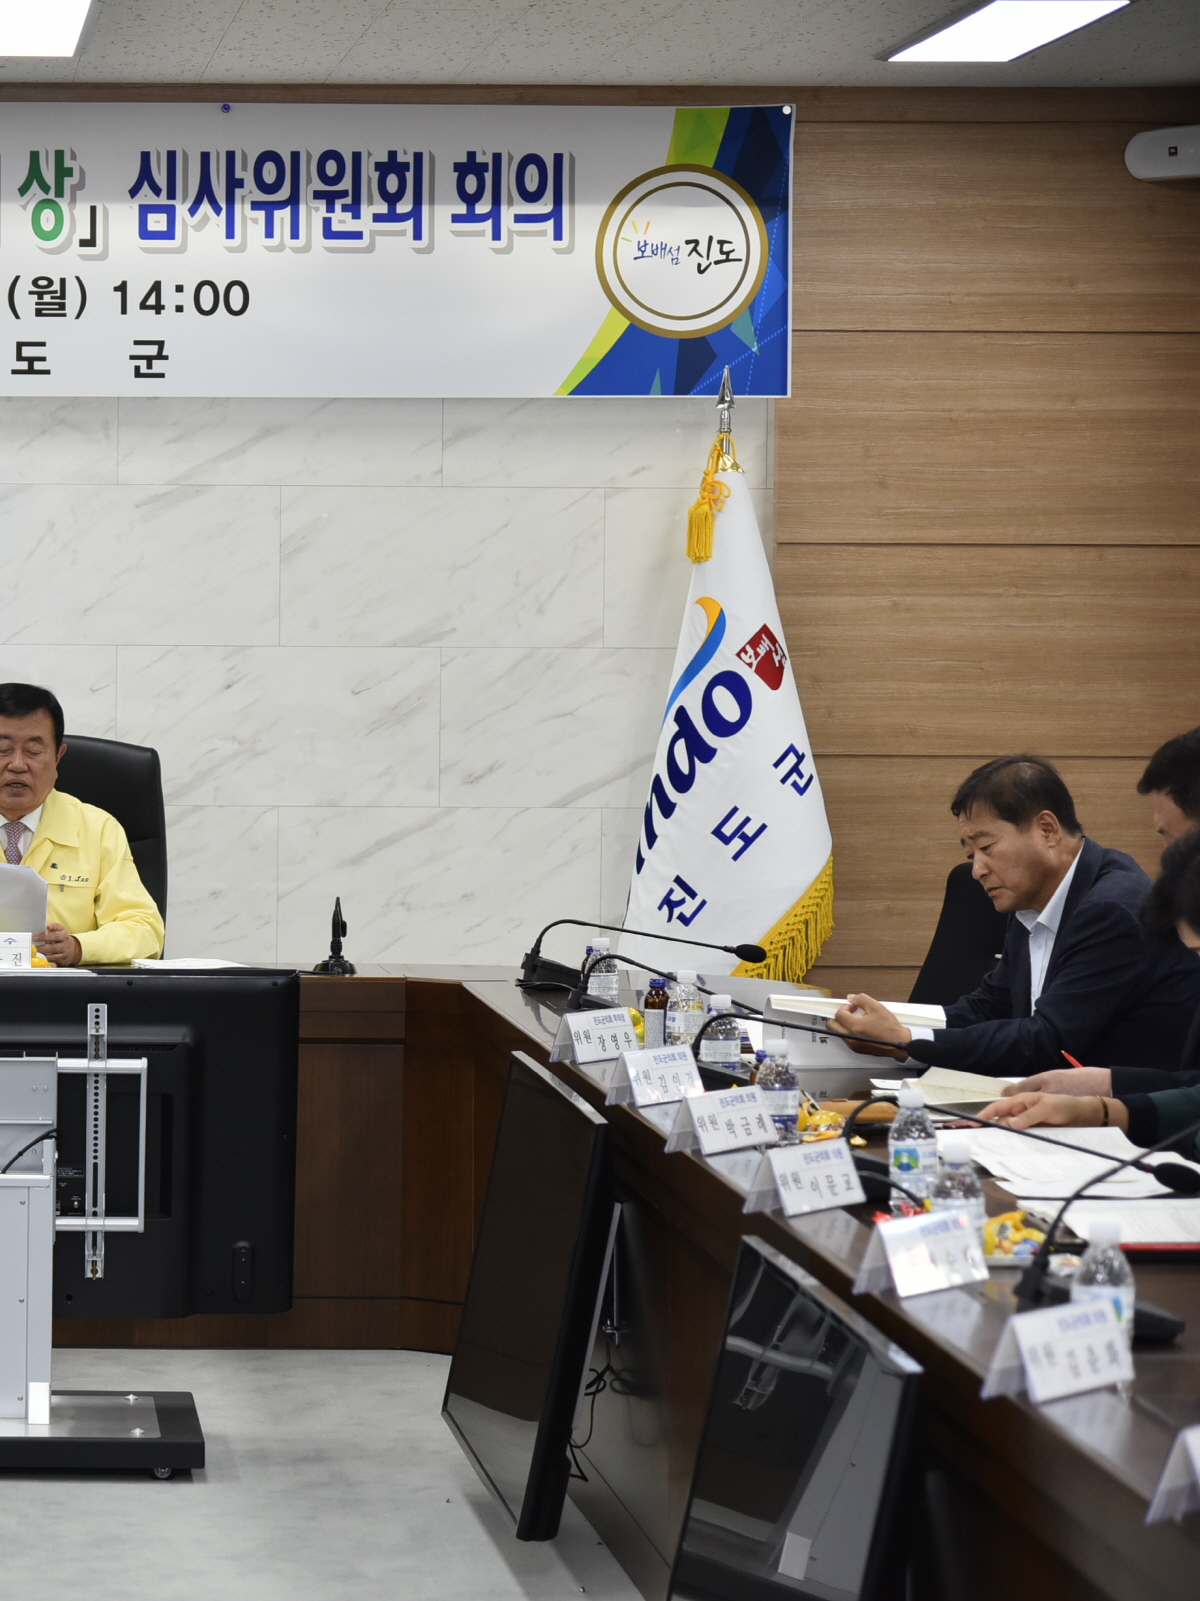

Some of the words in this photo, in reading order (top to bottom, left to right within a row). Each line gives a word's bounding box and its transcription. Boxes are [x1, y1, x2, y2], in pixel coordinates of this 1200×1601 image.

[17, 149, 97, 247] 상」
[128, 149, 423, 241] 심사위원회
[451, 150, 564, 242] 회의
[633, 240, 681, 266] 보배섬
[685, 234, 743, 275] 진도
[113, 279, 250, 317] 14:00
[592, 1015, 613, 1026] 진도군의회
[573, 1029, 592, 1046] 위원
[652, 1053, 677, 1065] 진도군의회
[697, 1113, 720, 1134] 위원
[779, 1170, 804, 1193] 위원
